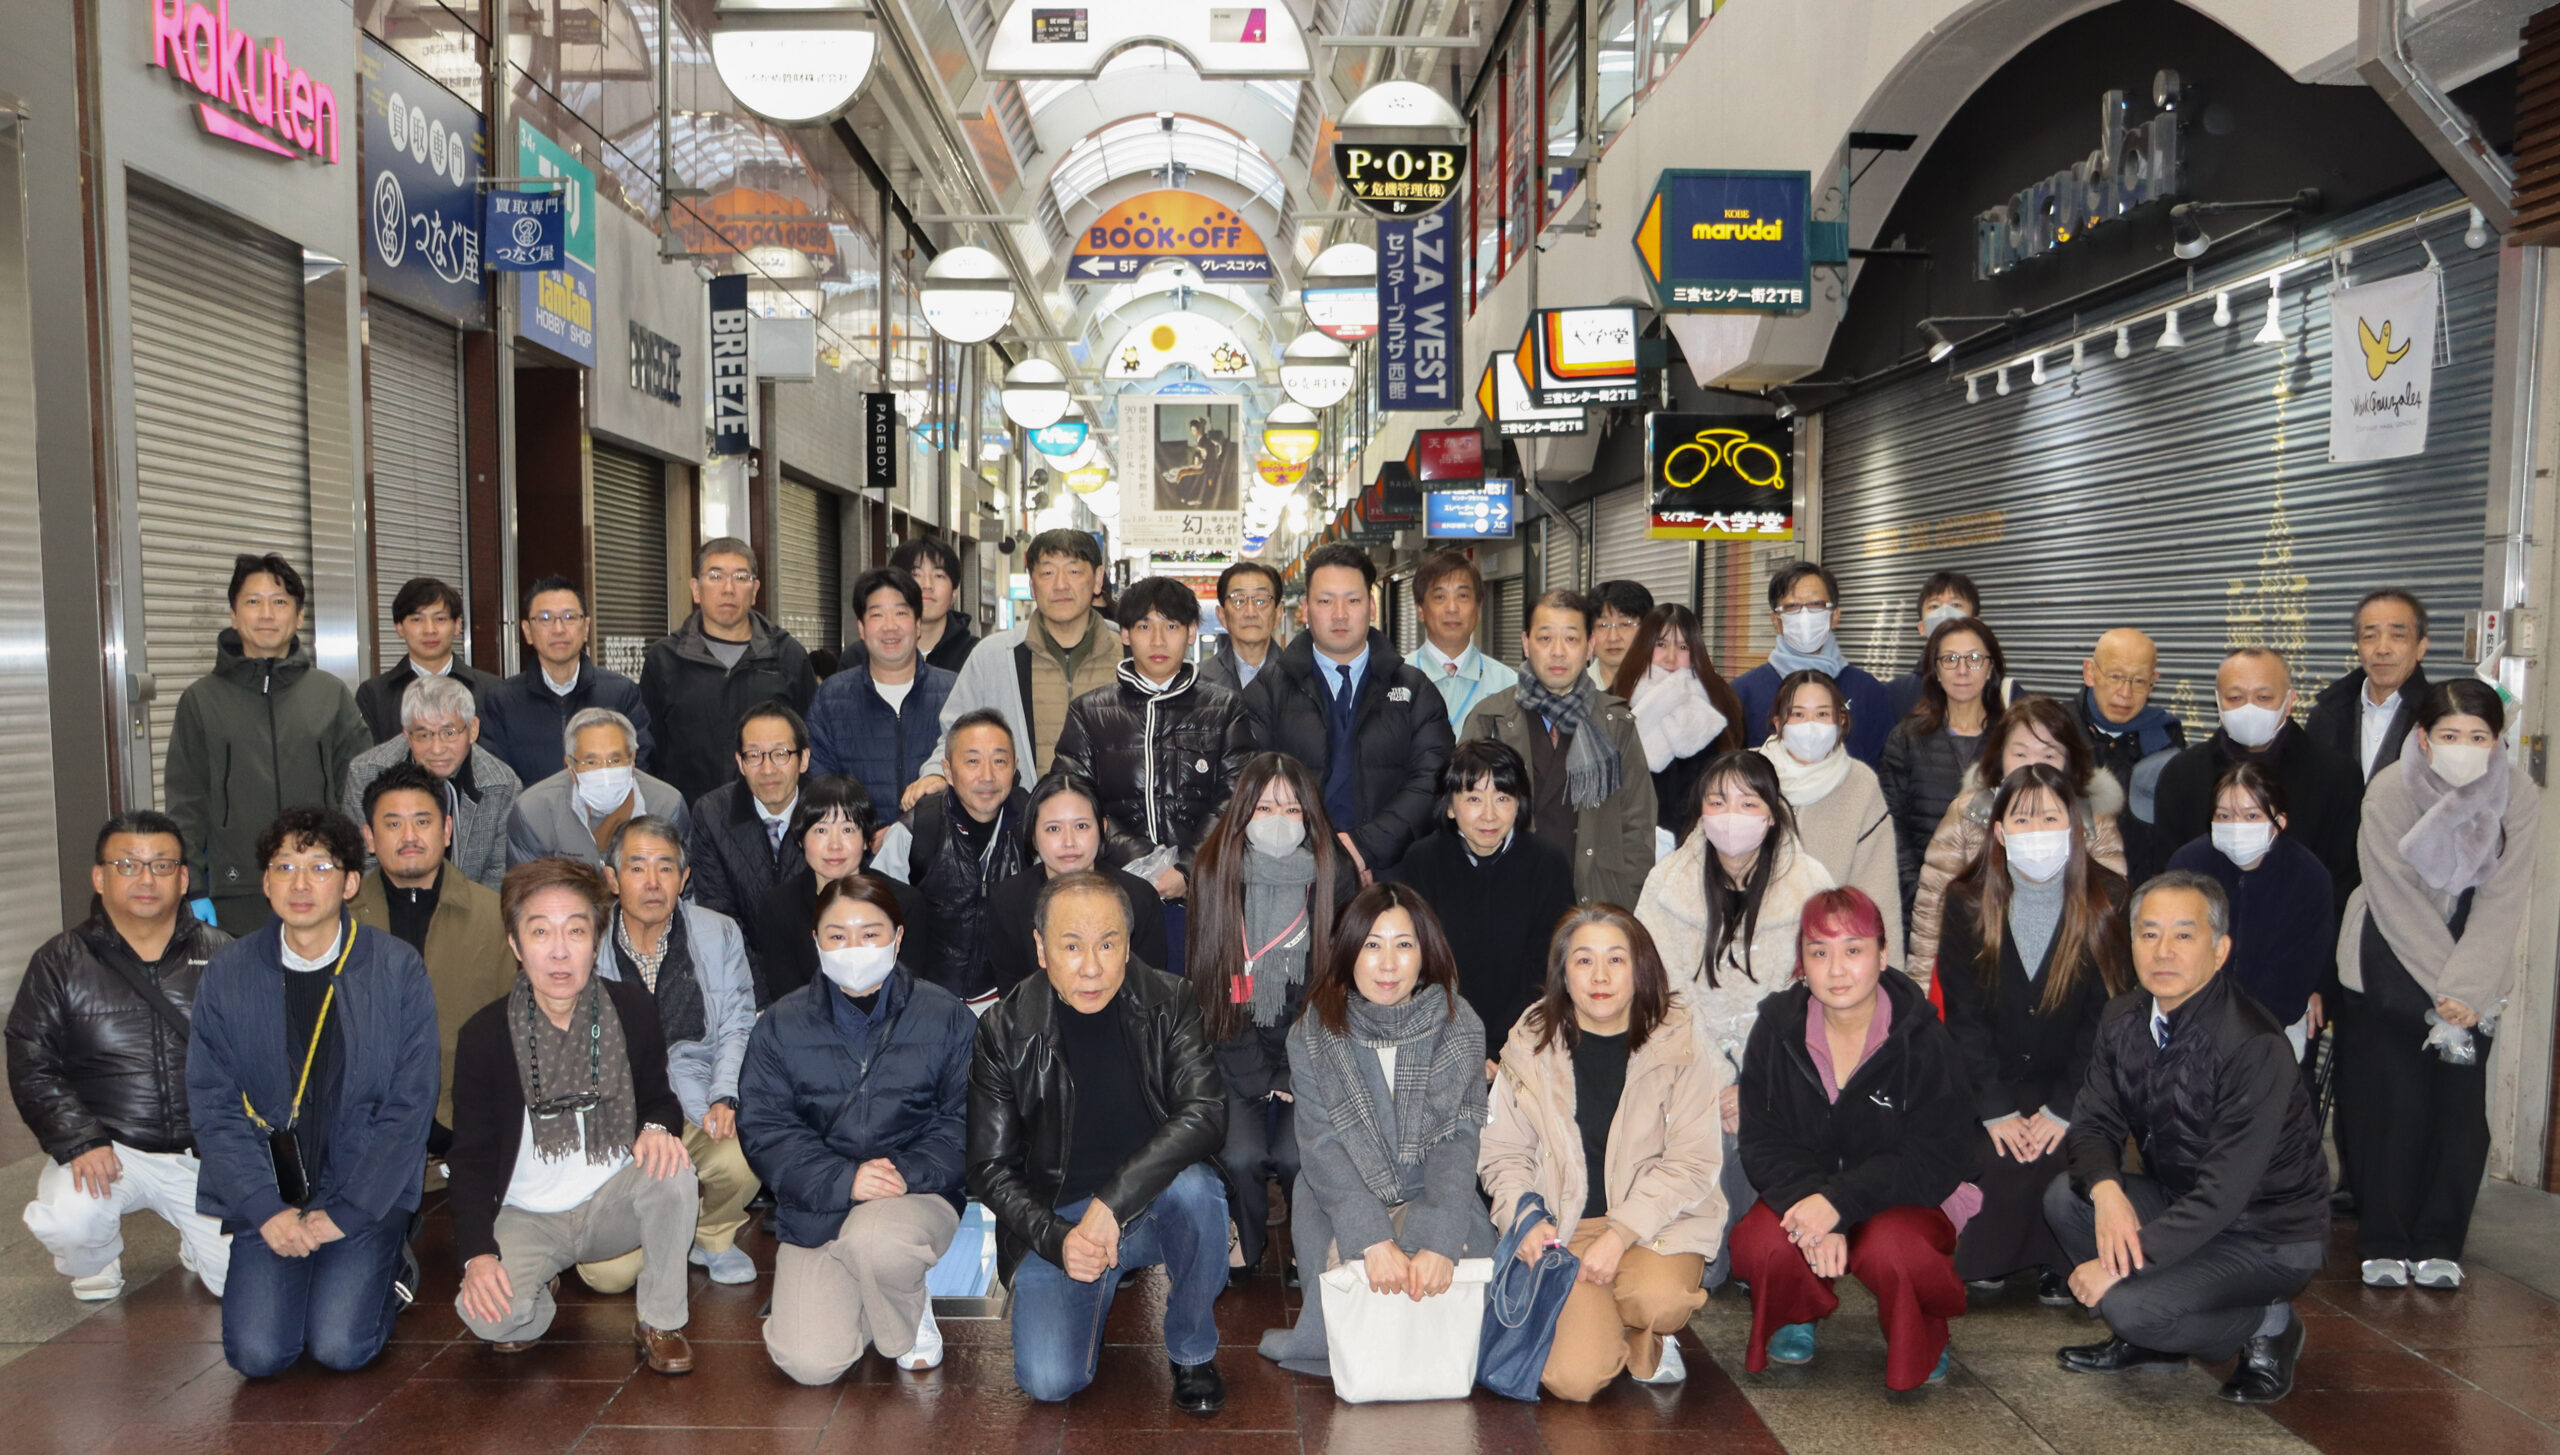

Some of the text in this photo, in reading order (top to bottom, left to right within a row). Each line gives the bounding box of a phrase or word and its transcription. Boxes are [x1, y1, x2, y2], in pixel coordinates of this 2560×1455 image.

[154, 0, 339, 165] Rakuten
[391, 101, 463, 183] 買取専門
[495, 197, 559, 215] 買取専門
[1393, 201, 1407, 213] 5F
[1724, 209, 1750, 219] KOBE
[1692, 218, 1783, 241] marudai
[411, 210, 480, 285] つなぐ屋
[496, 245, 554, 265] つなぐ屋
[1119, 260, 1138, 272] 5F
[1201, 260, 1267, 272] グレースコウベ
[538, 270, 592, 331] TamTam
[1673, 287, 1803, 304] 三宮センター街2丁目
[536, 307, 592, 349] HOBBY SHOP
[1414, 302, 1447, 400] WEST
[712, 309, 749, 436] BREEZE
[876, 403, 888, 478] PAGEBOY
[1660, 510, 1786, 534] マイスター 大学堂
